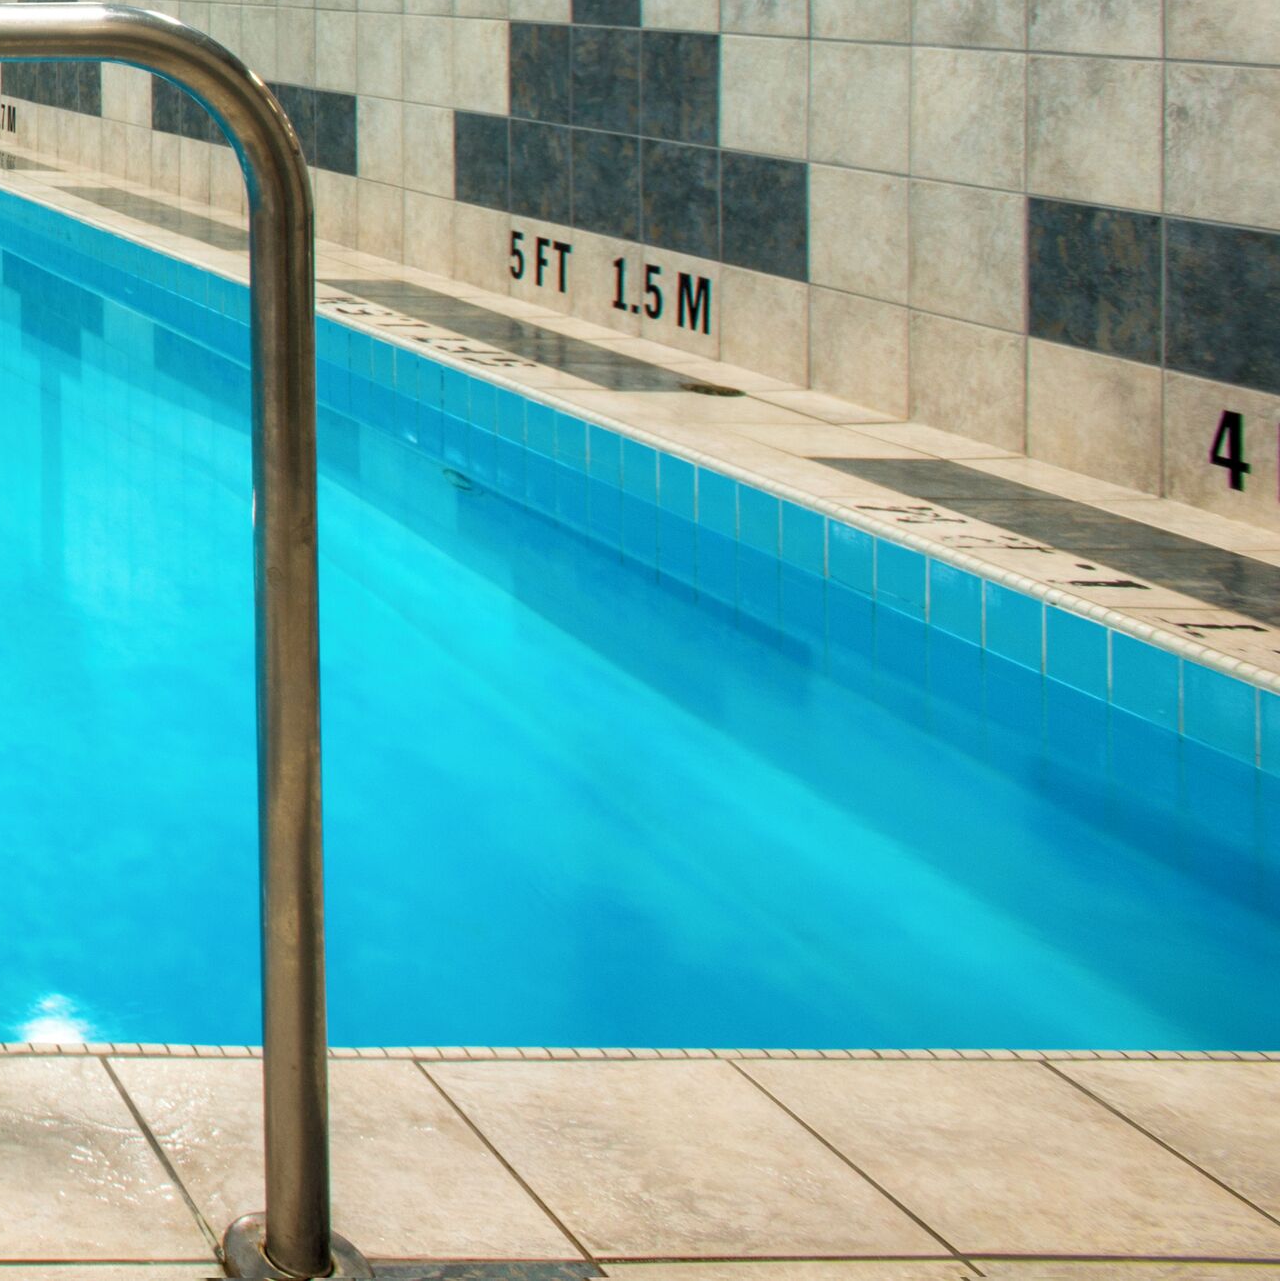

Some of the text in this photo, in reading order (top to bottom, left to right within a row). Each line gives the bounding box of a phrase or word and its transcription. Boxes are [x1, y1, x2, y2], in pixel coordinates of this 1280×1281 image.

[510, 230, 712, 335] 5 FT 1.5 M
[1209, 410, 1252, 492] 4
